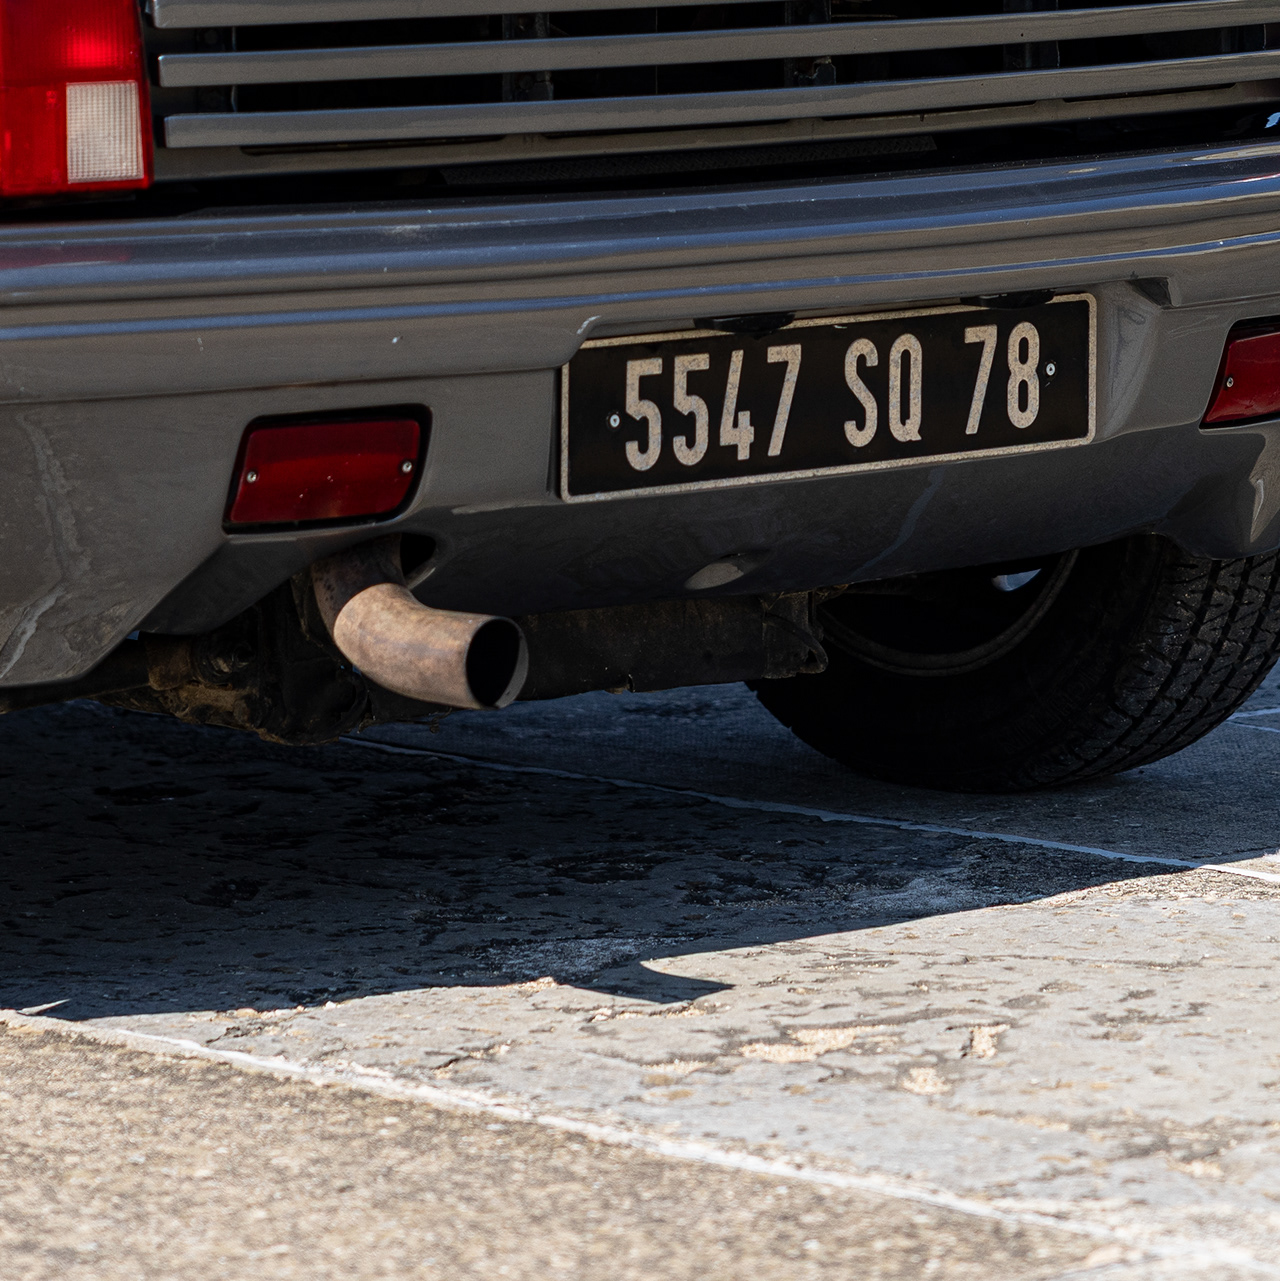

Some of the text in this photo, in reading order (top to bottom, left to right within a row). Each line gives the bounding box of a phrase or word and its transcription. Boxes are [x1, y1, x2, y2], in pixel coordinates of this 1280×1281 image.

[625, 321, 1040, 471] 5547 SQ 78
